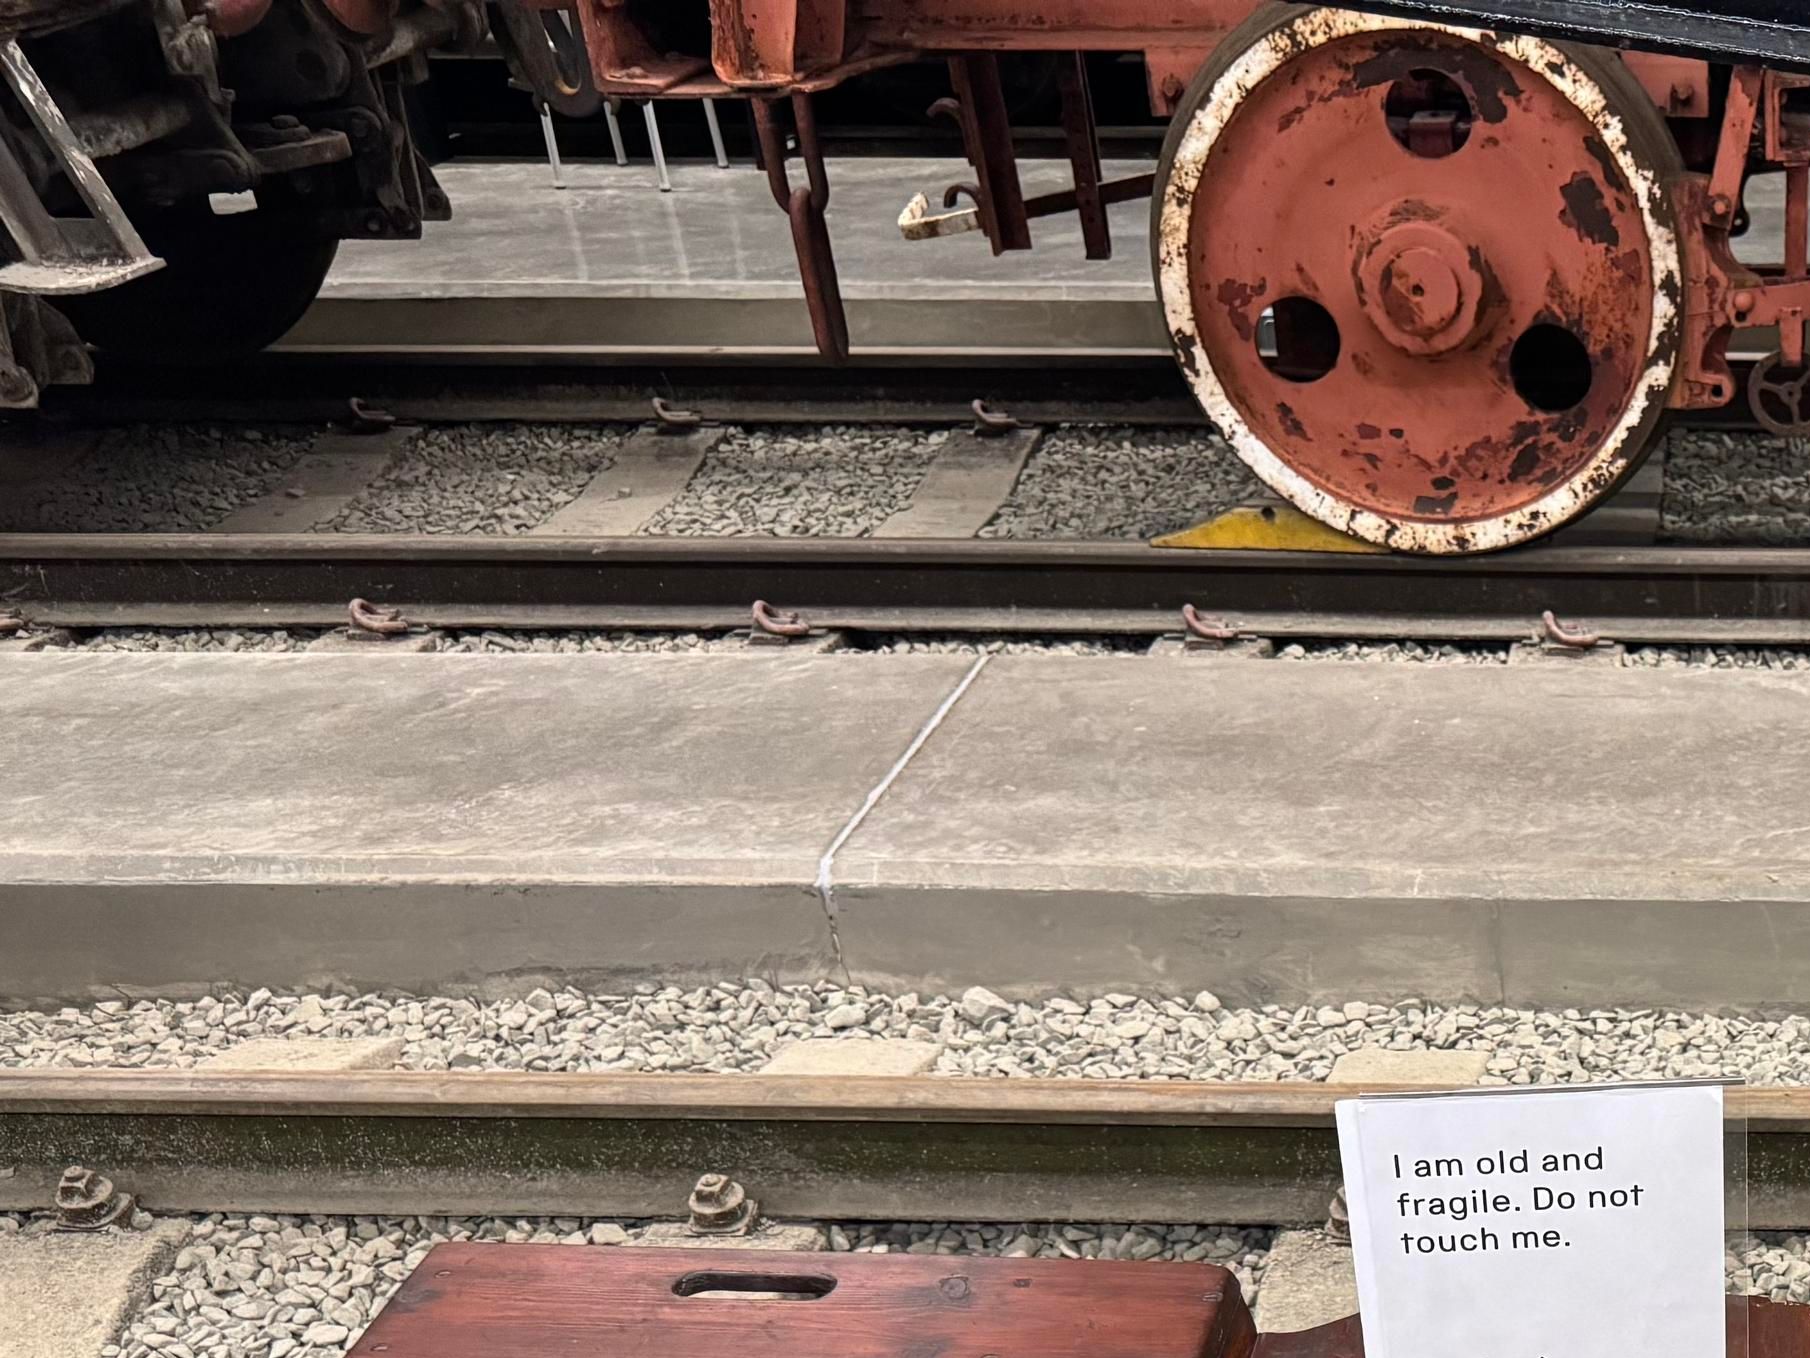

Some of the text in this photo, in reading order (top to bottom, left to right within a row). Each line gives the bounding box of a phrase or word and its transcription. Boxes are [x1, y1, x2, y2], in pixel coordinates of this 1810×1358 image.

[1393, 1146, 1604, 1179] I am old and
[1396, 1184, 1644, 1221] fragile. Do not
[1400, 1227, 1570, 1254] touch me.
